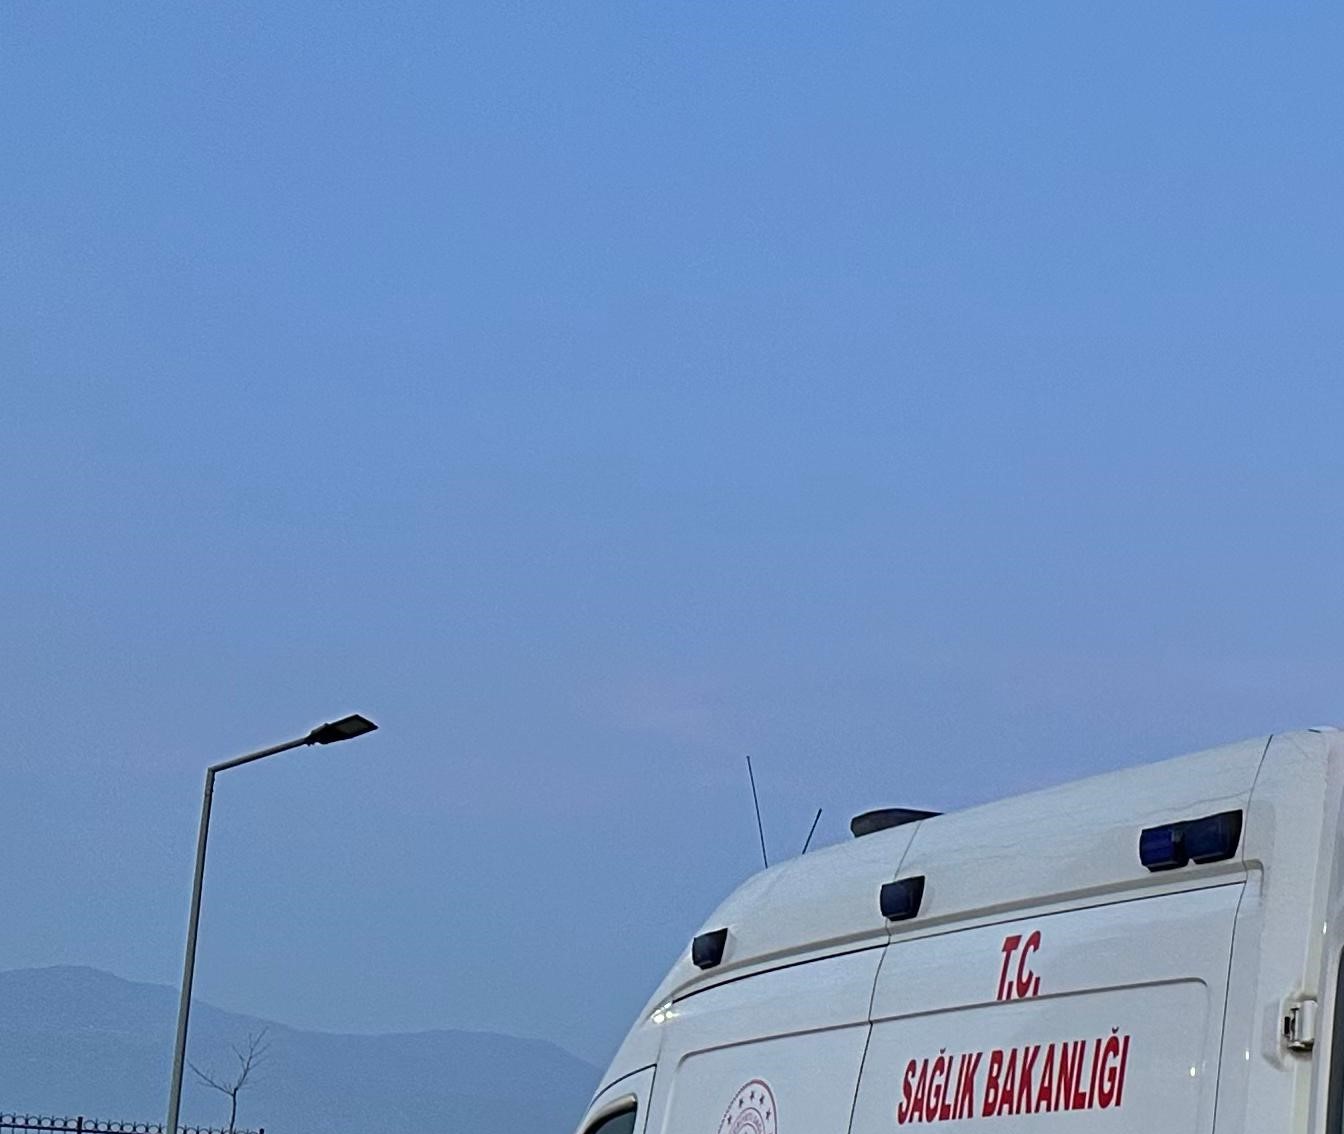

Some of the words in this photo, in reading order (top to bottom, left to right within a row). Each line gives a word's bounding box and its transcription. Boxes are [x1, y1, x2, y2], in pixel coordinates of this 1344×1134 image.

[997, 930, 1041, 1000] T.C.
[898, 1047, 983, 1125] SAĞLIK
[981, 1027, 1131, 1117] BAKANLIĞI
